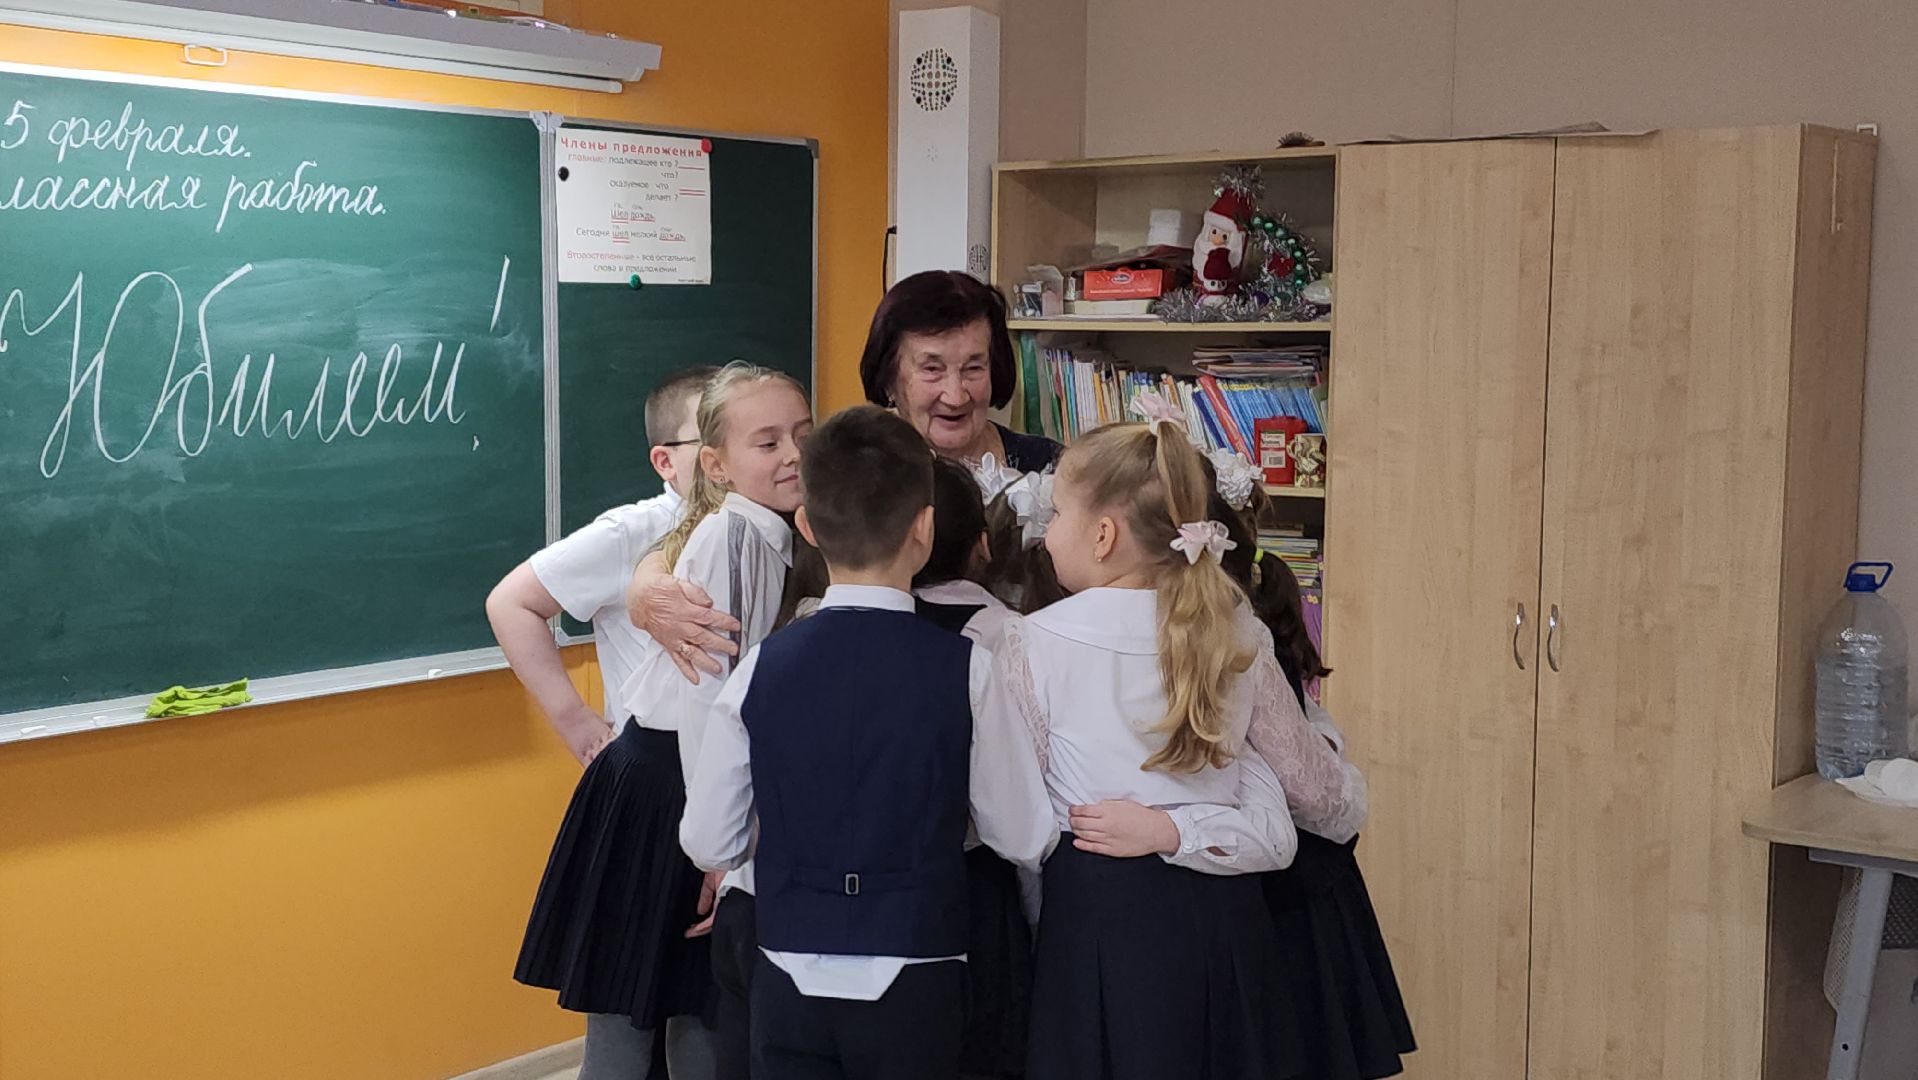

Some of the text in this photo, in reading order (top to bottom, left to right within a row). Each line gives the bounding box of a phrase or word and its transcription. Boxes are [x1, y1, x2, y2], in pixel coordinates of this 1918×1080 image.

[48, 102, 251, 170] февраля.
[560, 136, 702, 158] Члены предложения
[608, 155, 658, 168] подлежащее
[0, 160, 388, 233] лассная работа.
